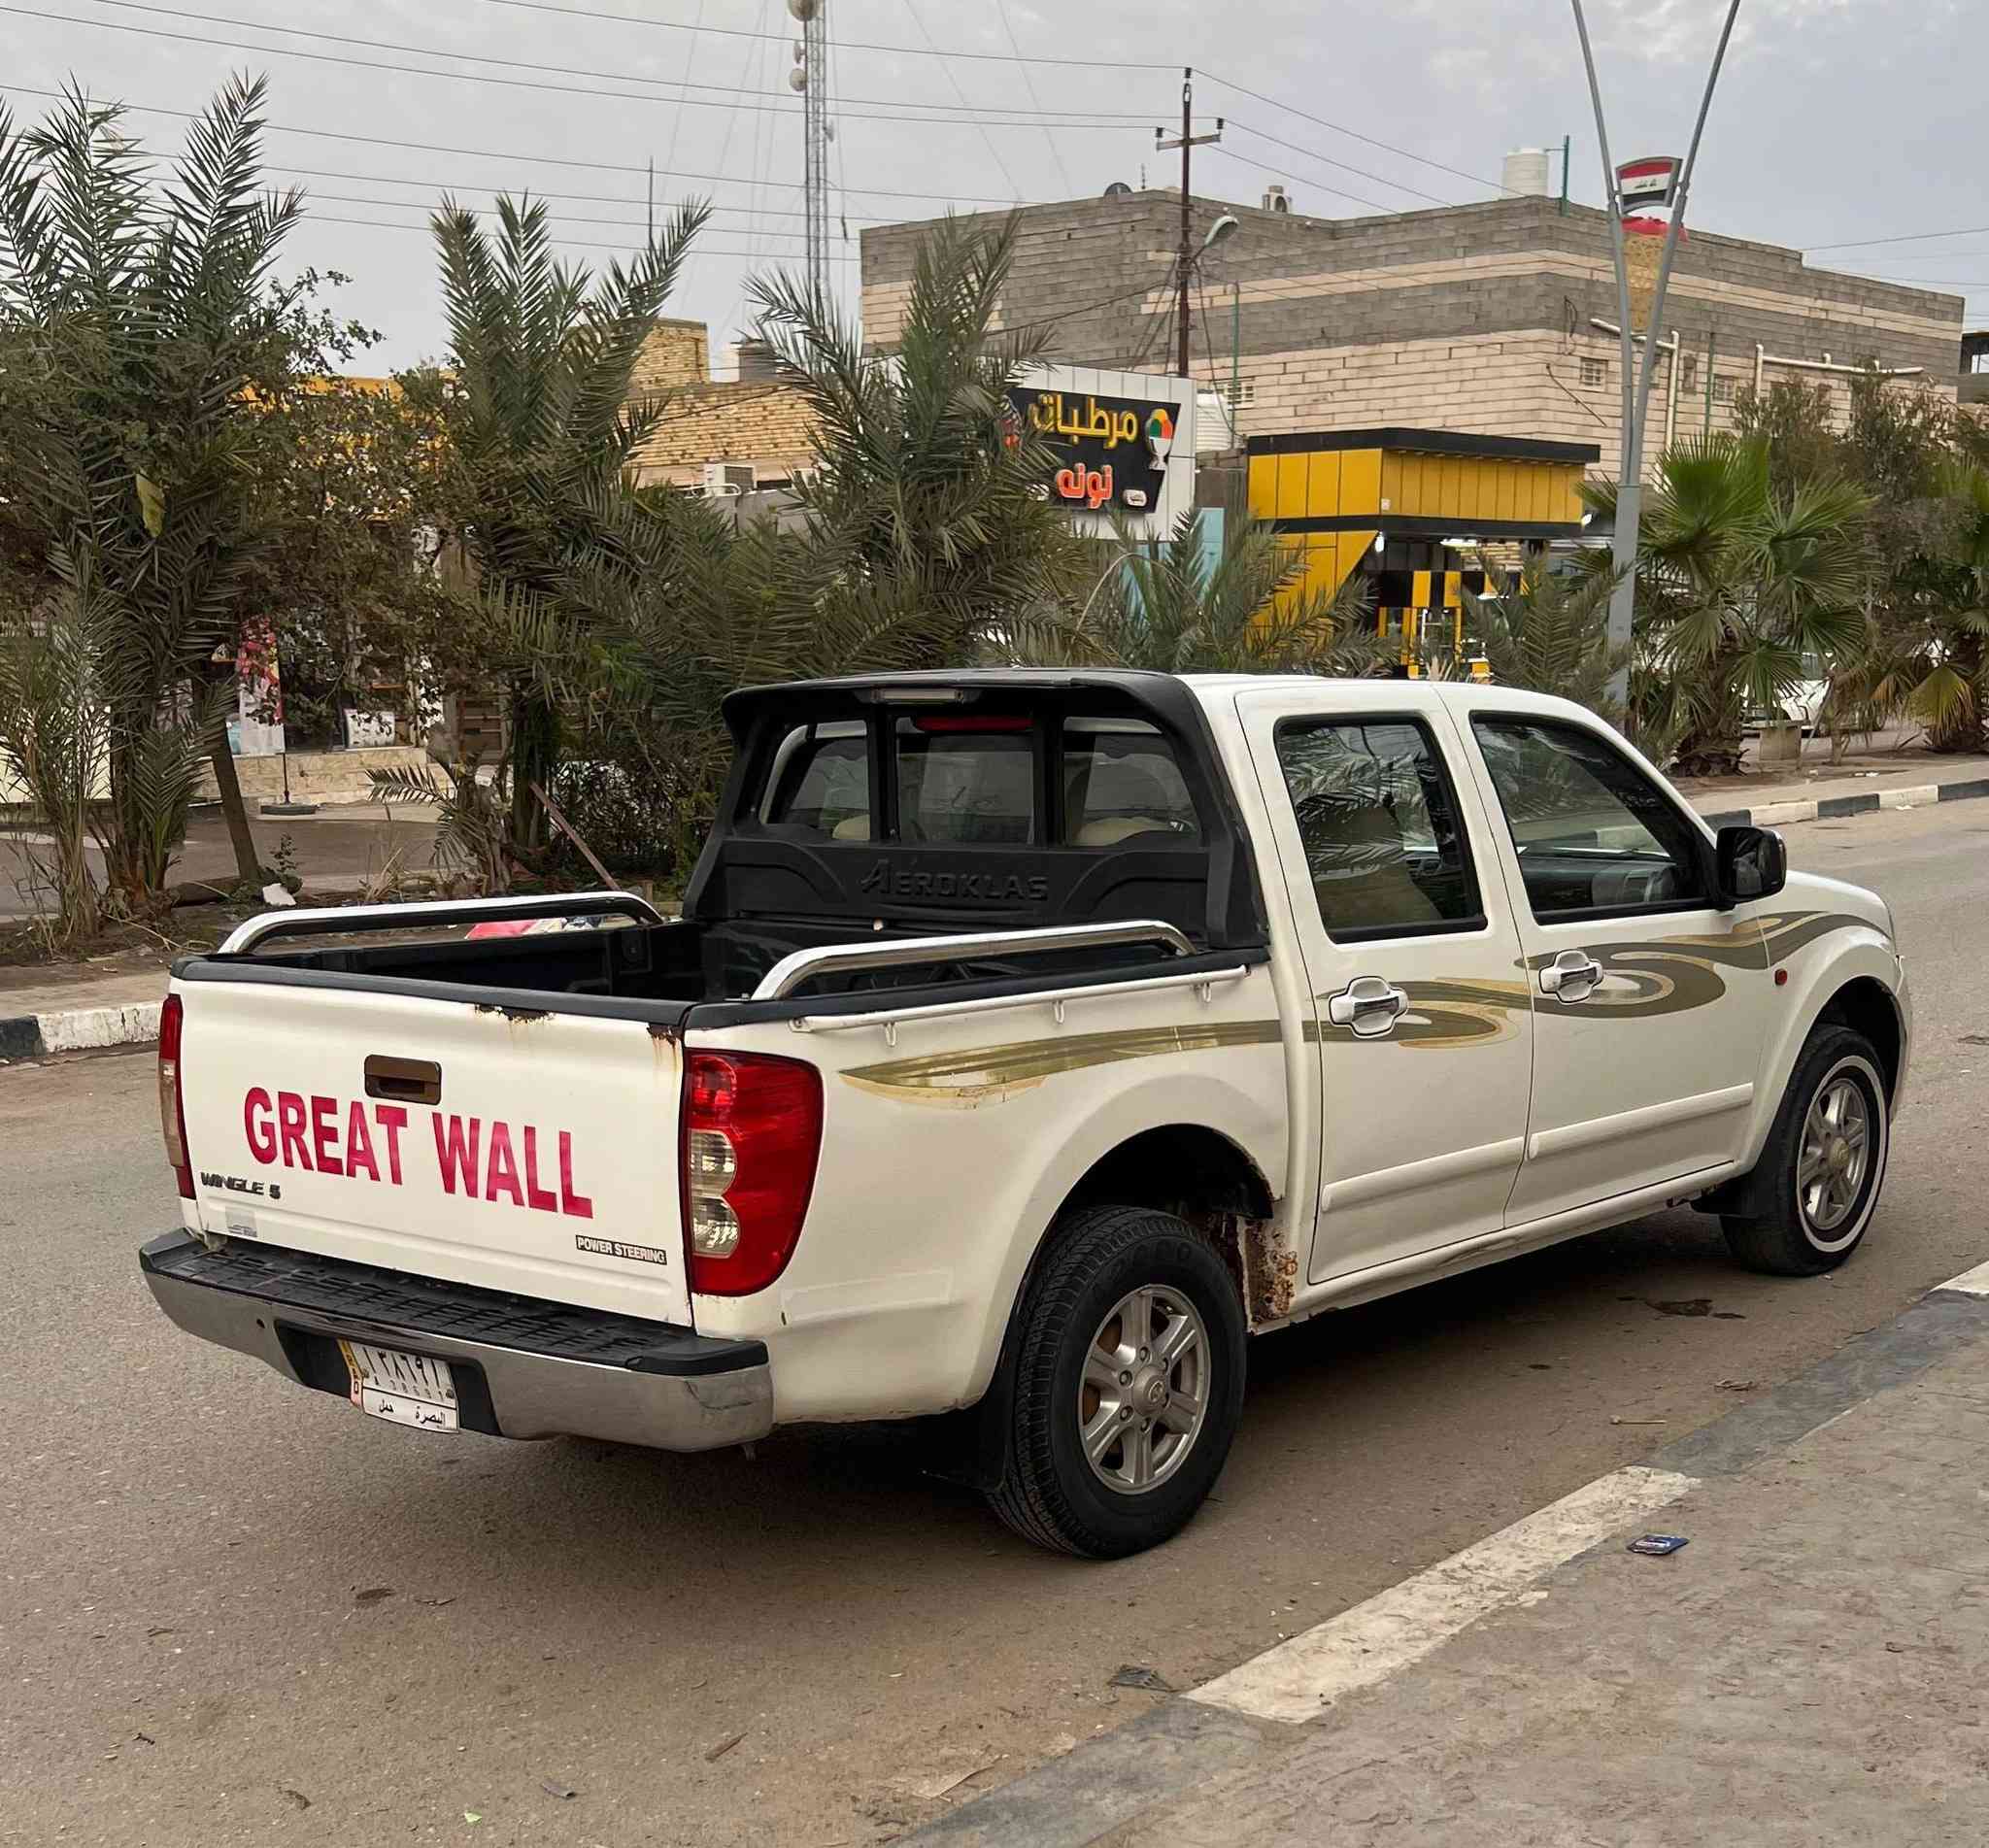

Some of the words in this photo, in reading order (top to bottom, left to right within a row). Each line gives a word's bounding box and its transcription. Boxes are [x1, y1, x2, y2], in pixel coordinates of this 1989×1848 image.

[1029, 393, 1138, 450] مرطبات
[1056, 462, 1114, 509] نون
[860, 858, 1049, 901] AEROKLAS
[245, 1086, 409, 1185] GREAT
[432, 1112, 593, 1219] WALL
[200, 1172, 264, 1195] WINGLE
[269, 1184, 281, 1199] 5
[577, 1236, 613, 1254] POWER
[614, 1243, 665, 1262] STEERING
